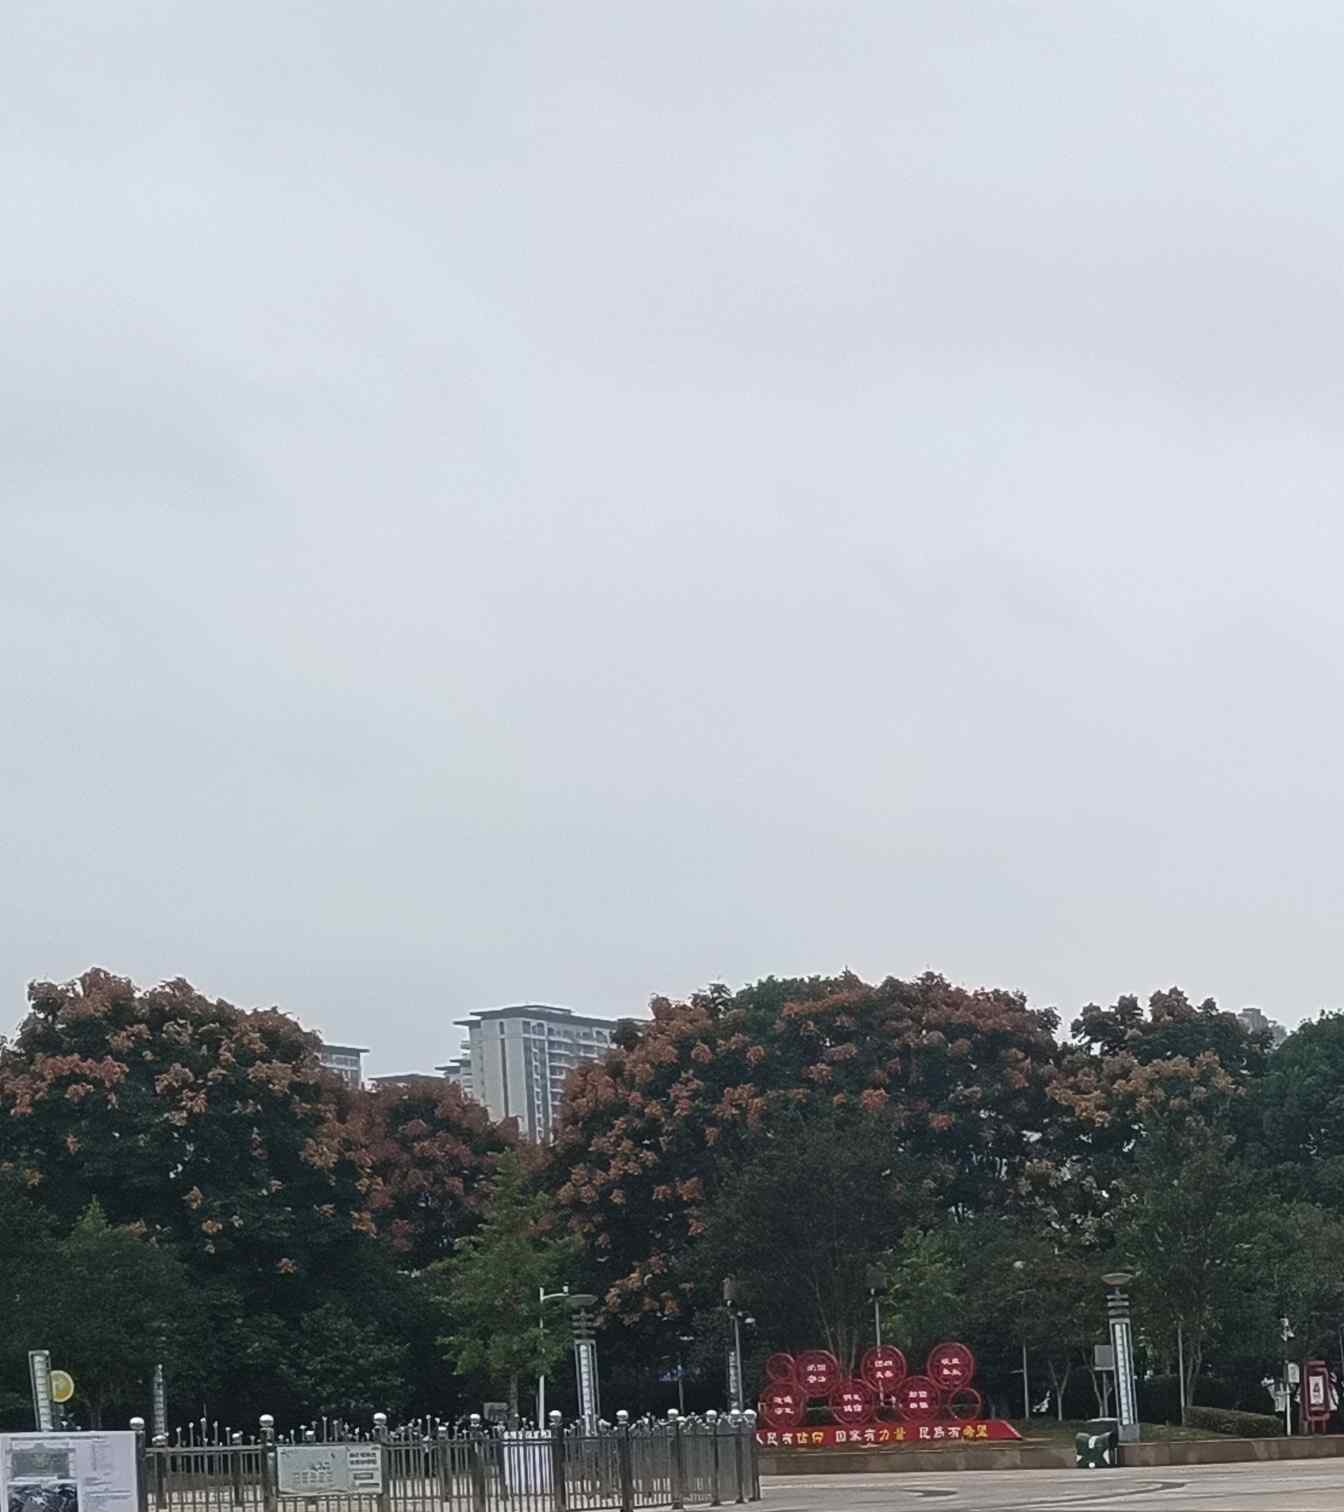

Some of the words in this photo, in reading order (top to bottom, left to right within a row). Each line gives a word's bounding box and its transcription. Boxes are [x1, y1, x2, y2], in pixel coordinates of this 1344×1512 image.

[834, 1426, 907, 1443] 国家有力量
[918, 1424, 989, 1440] 民族有希望
